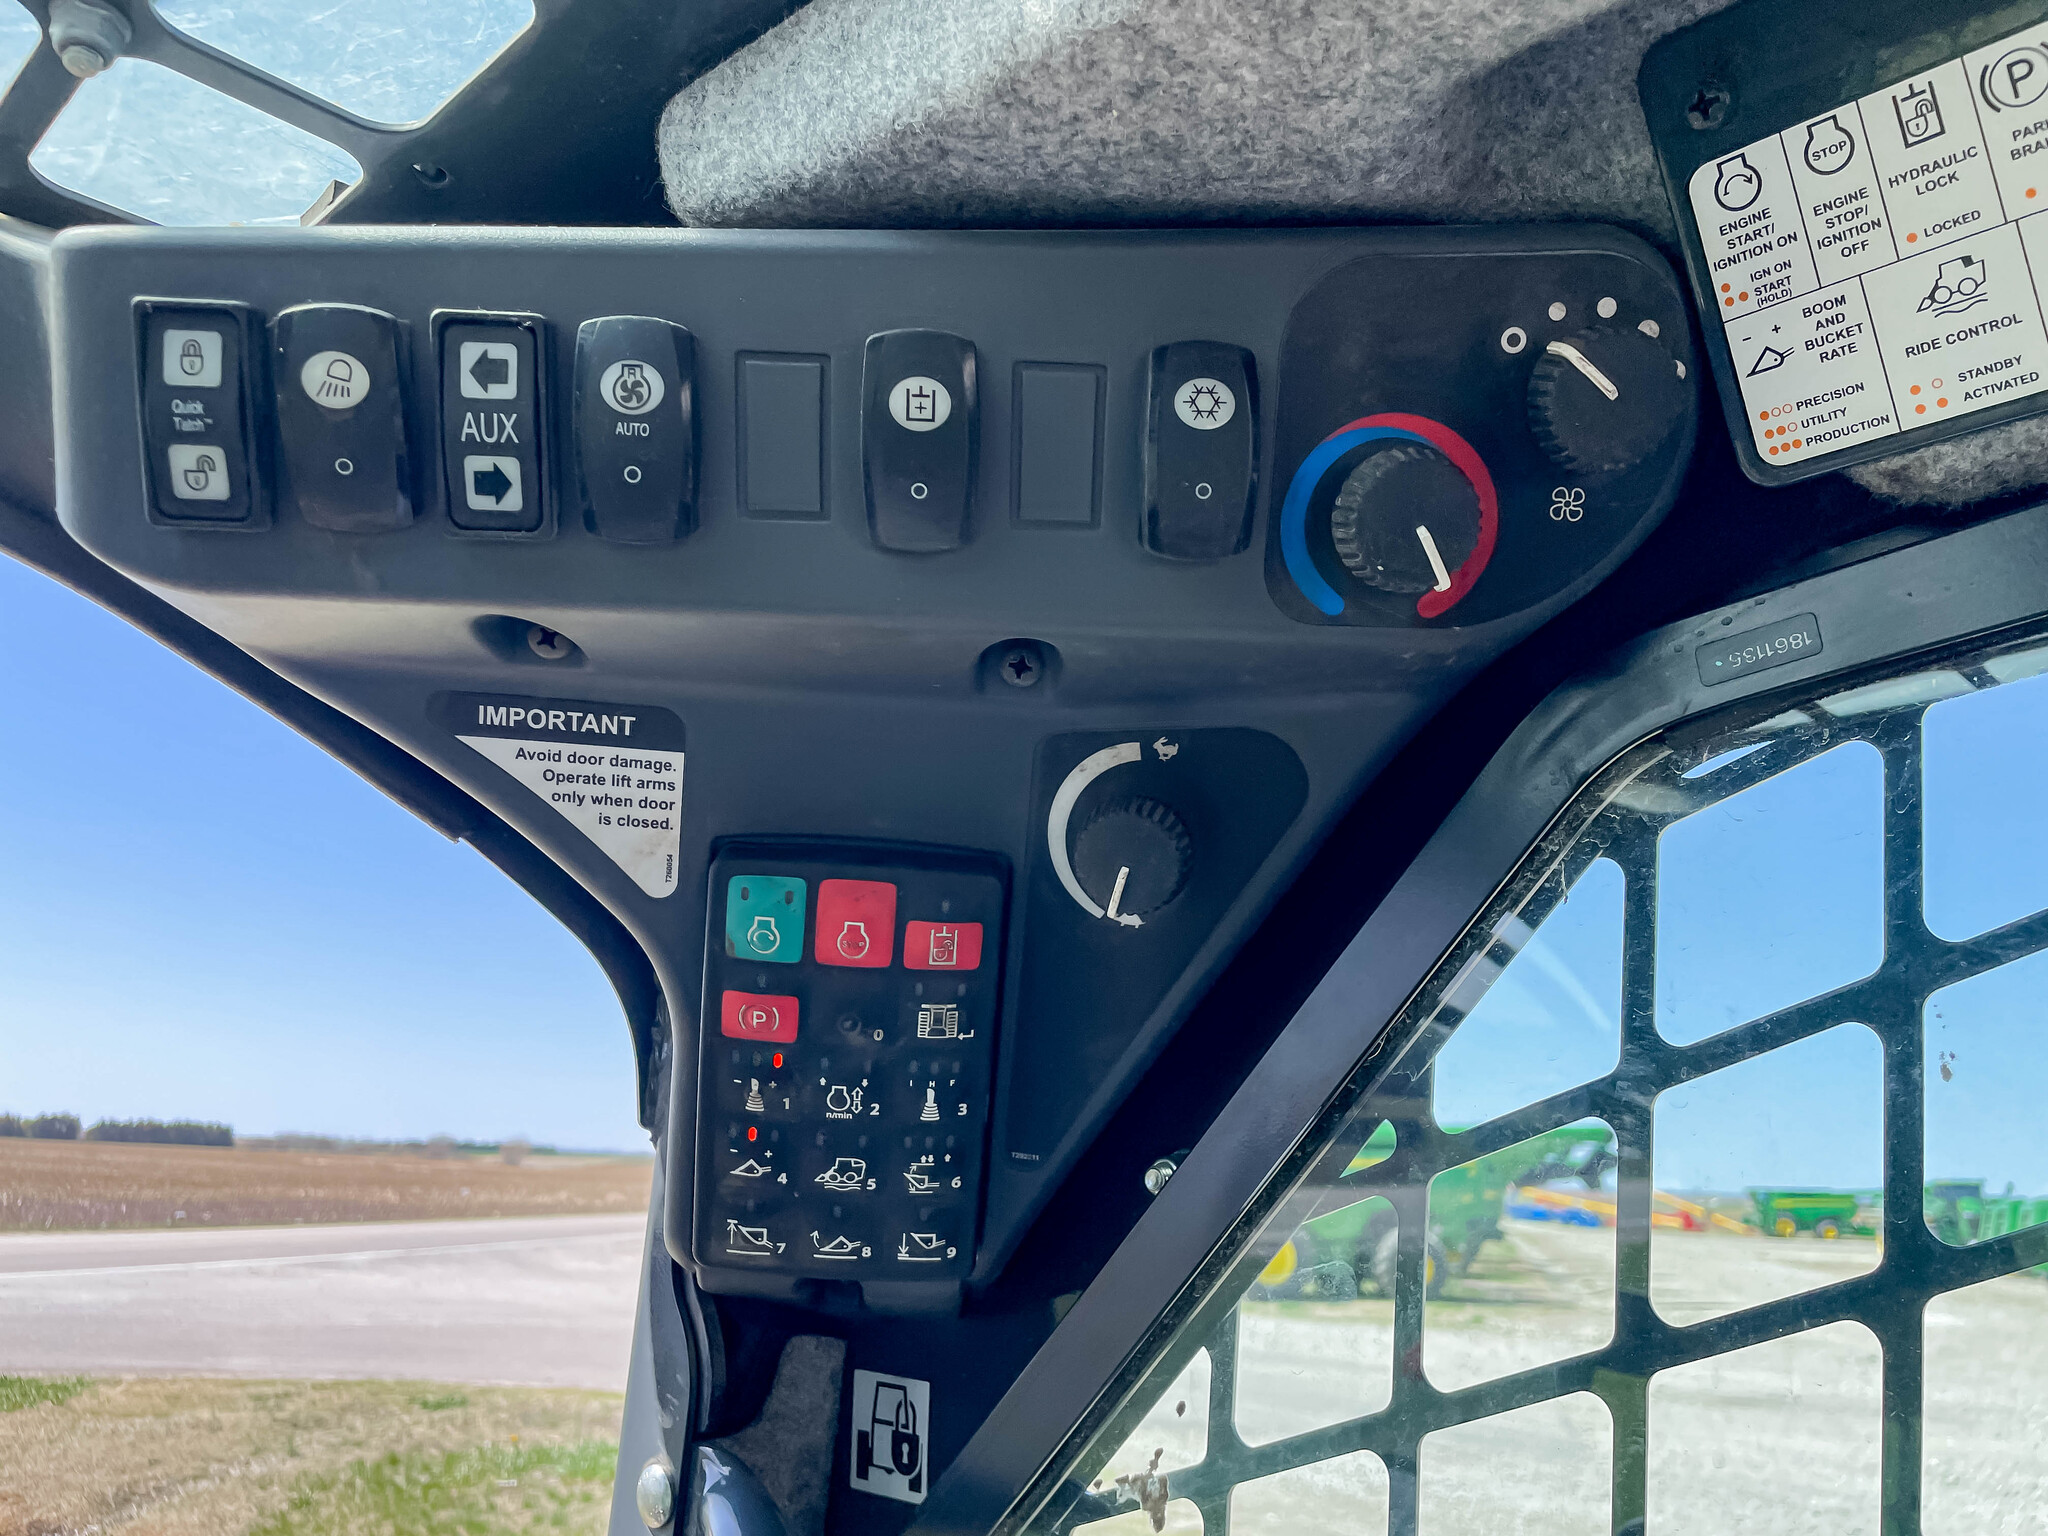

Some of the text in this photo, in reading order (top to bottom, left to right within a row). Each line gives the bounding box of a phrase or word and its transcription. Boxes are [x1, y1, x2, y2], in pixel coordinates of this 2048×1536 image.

[1811, 140, 1848, 162] STOP
[1888, 146, 1979, 189] HYDRAULIC
[1916, 170, 1960, 197] LOCK
[1812, 187, 1870, 217] ENGINE
[1718, 207, 1772, 237] ENGINE
[1826, 203, 1869, 230] STOP/
[1923, 209, 1982, 239] LOCKED
[1726, 223, 1776, 250] START/
[1816, 217, 1882, 250] IGNITION
[1713, 232, 1798, 273] IGNITION ON
[1840, 239, 1870, 259] OFF
[1749, 259, 1793, 283] IGN ON
[1754, 275, 1793, 297] START
[1756, 287, 1793, 308] (HOLD)
[1801, 294, 1848, 319] BOOM
[1815, 312, 1846, 332] AND
[1804, 322, 1864, 352] BUCKET
[1904, 313, 2023, 359] RIDE CONTROL
[1819, 341, 1859, 364] RATE
[1957, 355, 2023, 383] STANDBY
[1795, 381, 1865, 412] PRECISION
[1963, 371, 2040, 402] ACTIVATED
[461, 412, 518, 444] AUX
[615, 421, 650, 437] AUTO
[1801, 406, 1848, 430] UTILITY
[1805, 414, 1891, 447] PRODUCTION
[1729, 631, 1813, 668] 1861135
[478, 704, 637, 736] IMPORTANT
[515, 747, 677, 774] Avoid door damage.
[542, 768, 676, 792] Operate lift arms
[551, 790, 676, 811] only when door
[598, 812, 674, 831] is closed.
[873, 1029, 884, 1041] 0
[949, 1079, 955, 1087] F
[782, 1098, 790, 1110] 1
[825, 1111, 853, 1120] n/min
[870, 1104, 880, 1116] 2
[957, 1103, 968, 1116] 3
[777, 1172, 788, 1185] 4
[866, 1178, 877, 1190] 5
[951, 1176, 961, 1188] 6
[776, 1242, 787, 1254] 7
[861, 1246, 872, 1258] 8
[946, 1247, 957, 1258] 9
